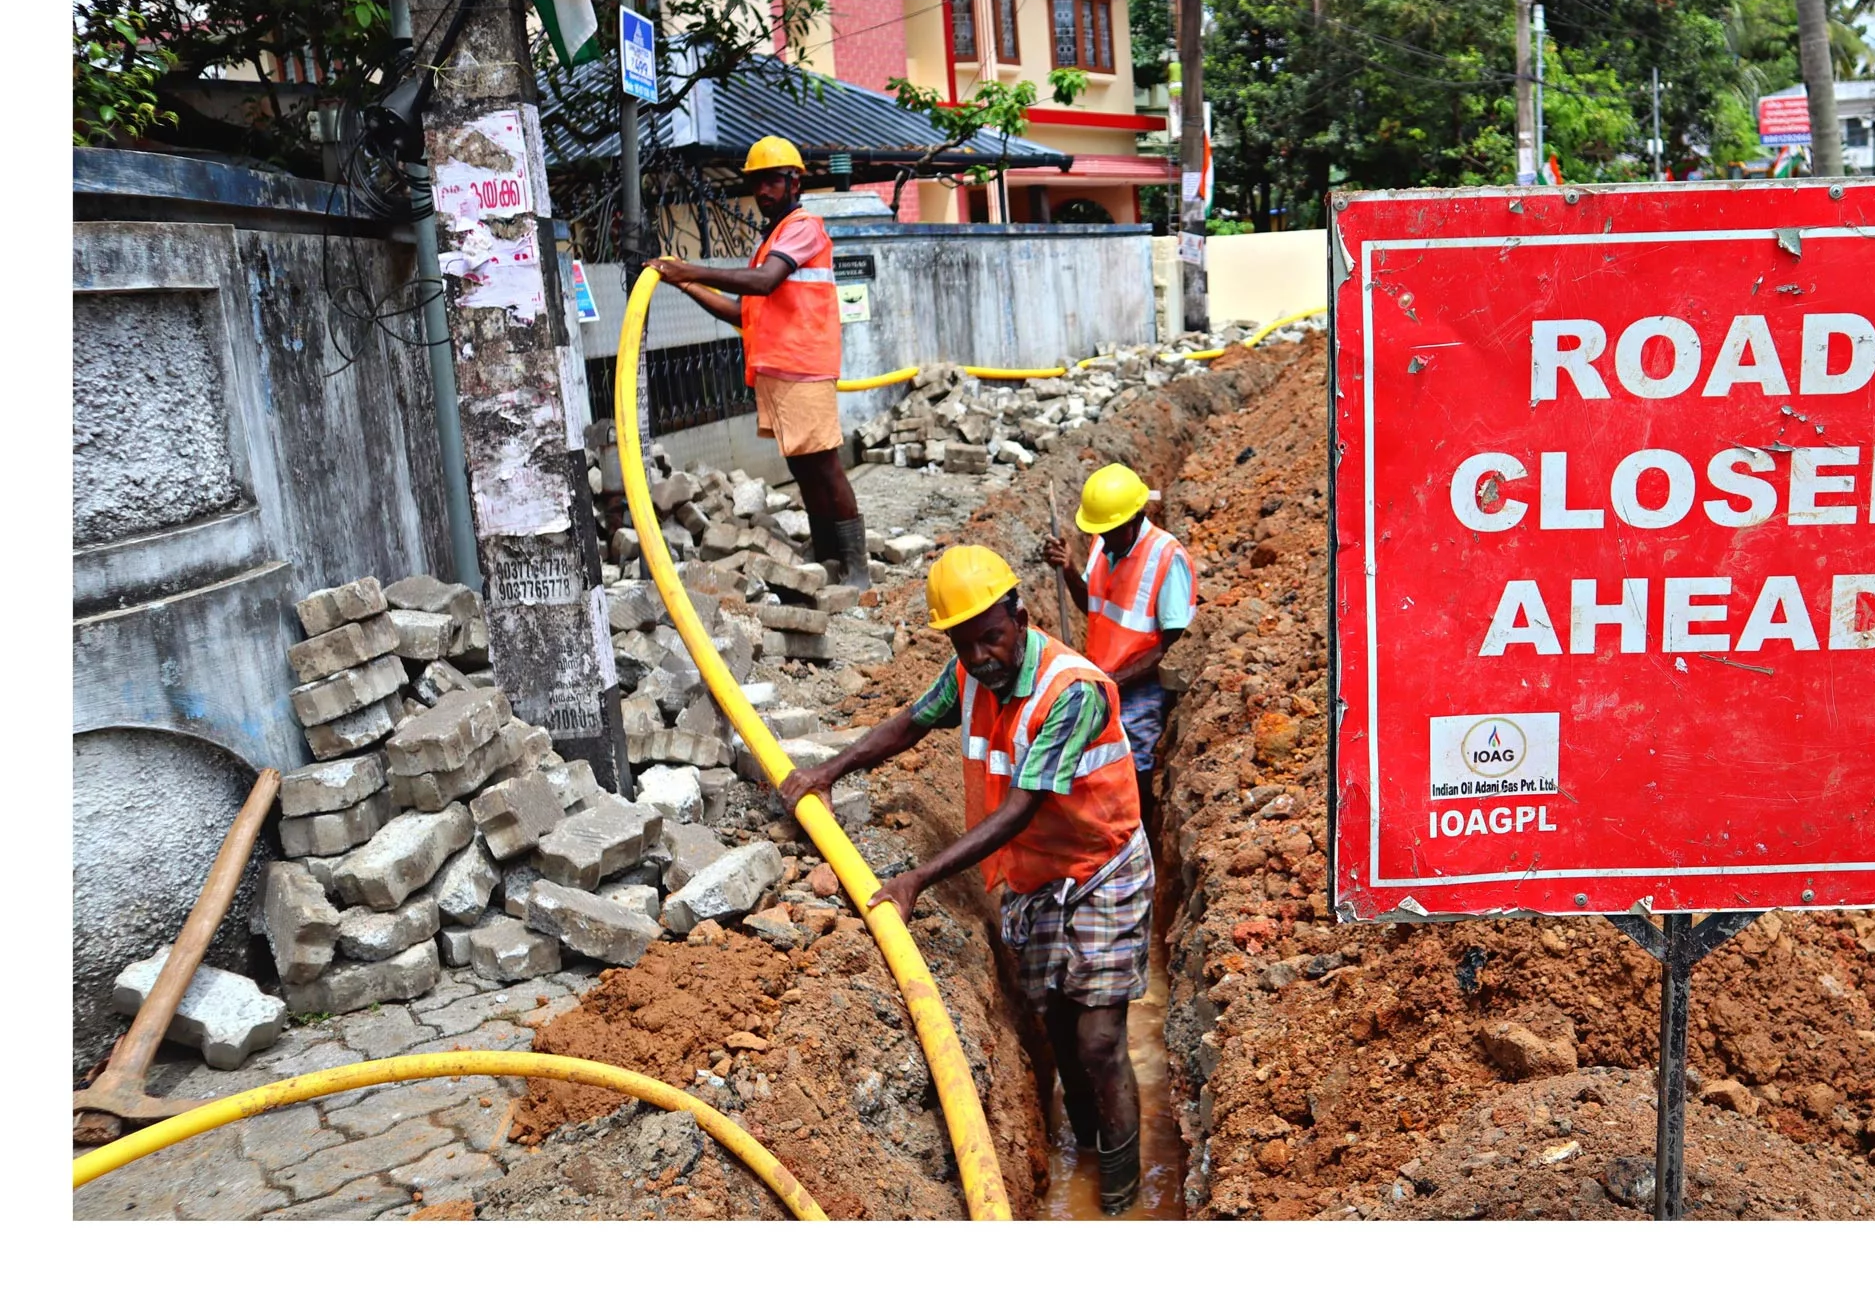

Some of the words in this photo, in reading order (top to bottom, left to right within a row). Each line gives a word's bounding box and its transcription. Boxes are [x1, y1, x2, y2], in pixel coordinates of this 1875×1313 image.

[498, 579, 572, 602] 9037765778
[1473, 748, 1514, 763] IOAG
[1432, 784, 1458, 797] Indian
[1460, 782, 1473, 796] Oil
[1474, 780, 1500, 794] Adani
[1501, 780, 1518, 793] Gas
[1520, 778, 1537, 792] Pvt.
[1430, 806, 1556, 839] IOAGPL
